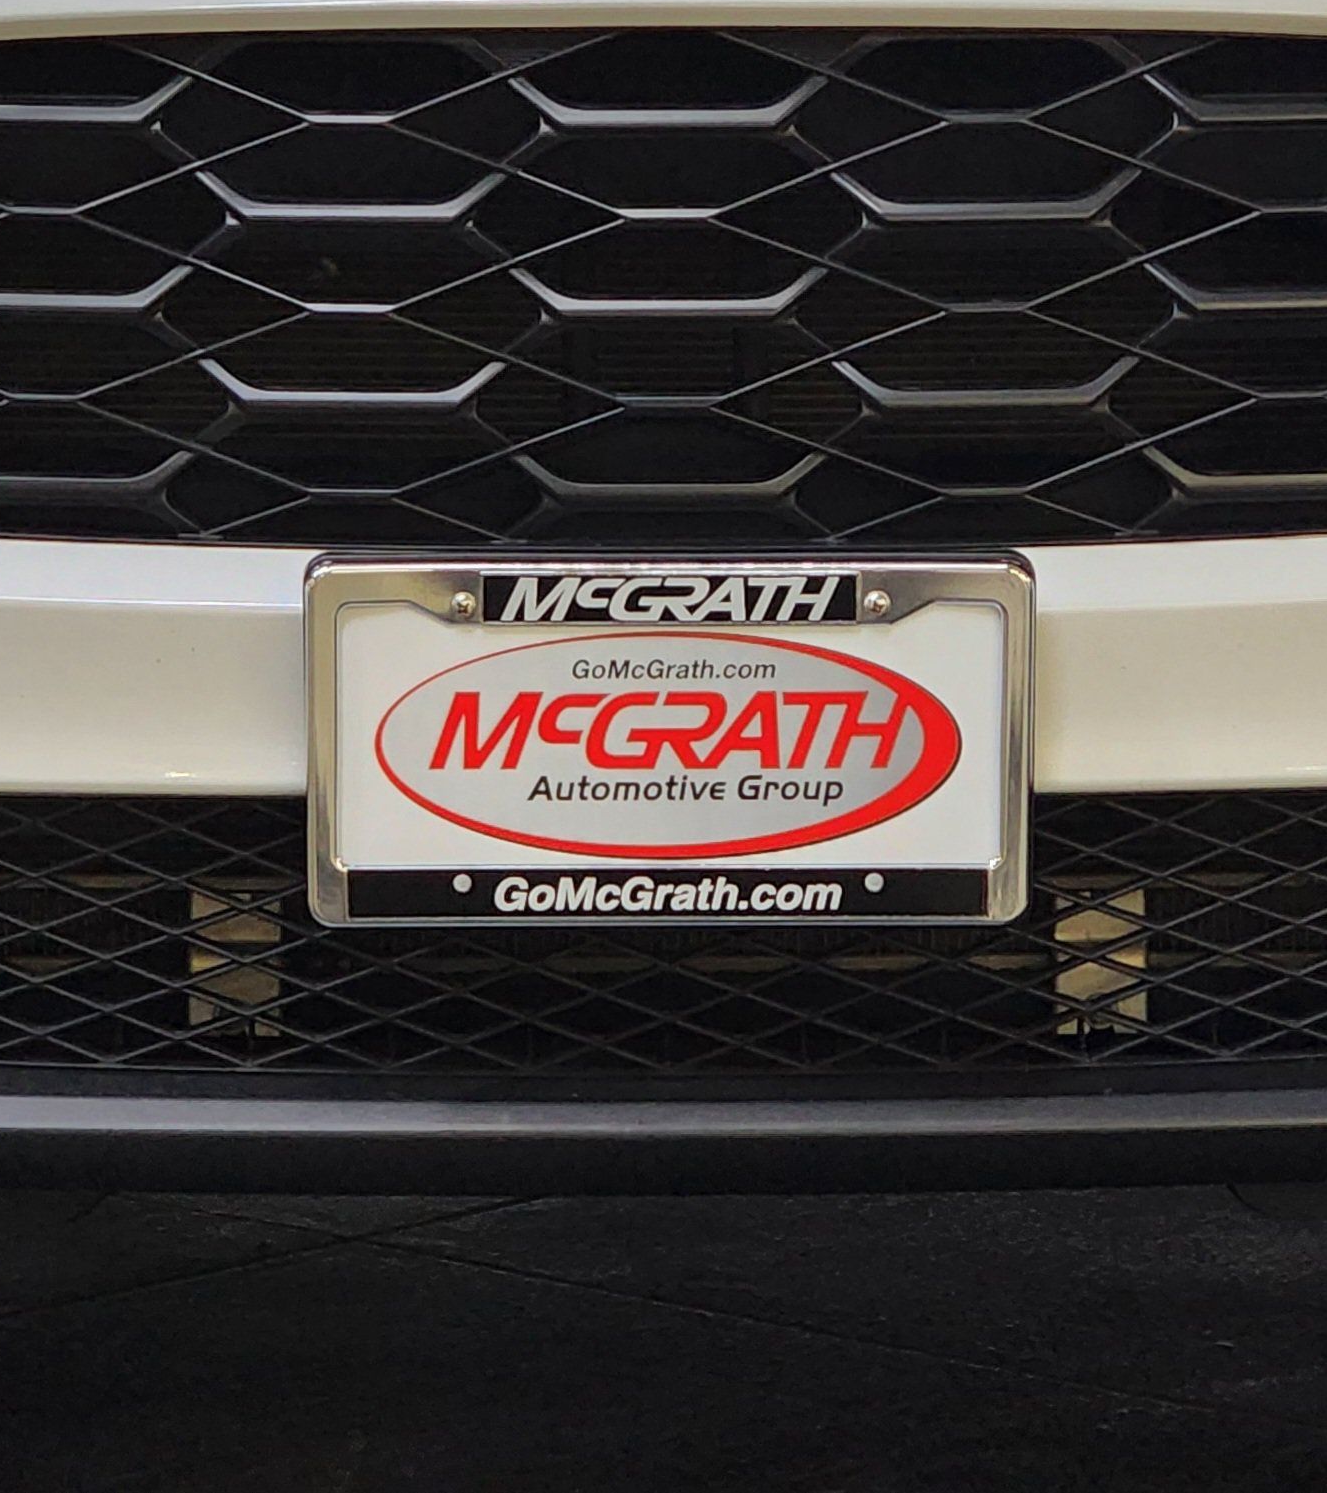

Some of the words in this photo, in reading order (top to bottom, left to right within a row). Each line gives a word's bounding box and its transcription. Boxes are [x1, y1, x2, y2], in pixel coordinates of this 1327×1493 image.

[571, 658, 777, 680] GoMcGrath.com
[526, 774, 727, 802] Automotive
[736, 774, 845, 808] Group
[493, 875, 843, 912] GoMcGrath.com
